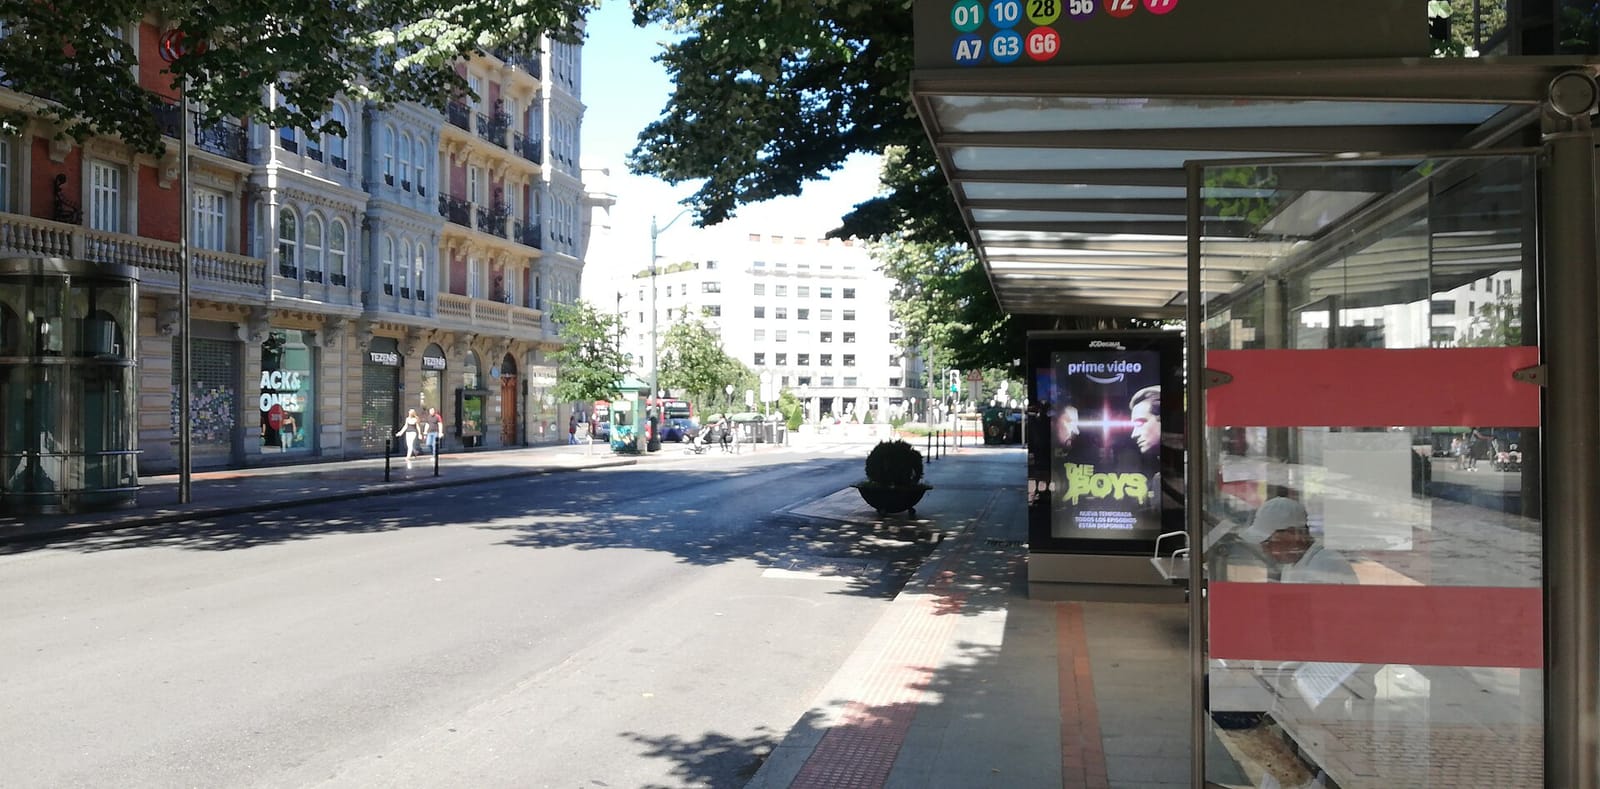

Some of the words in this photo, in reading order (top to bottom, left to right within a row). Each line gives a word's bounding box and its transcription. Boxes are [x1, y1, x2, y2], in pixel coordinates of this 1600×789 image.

[954, 5, 980, 25] 01
[994, 2, 1018, 22] 10
[1032, 0, 1055, 18] 28
[1069, 0, 1094, 15] 56
[955, 40, 982, 60] A7
[993, 36, 1019, 56] G3
[1029, 33, 1057, 54] G6
[1068, 361, 1105, 376] prime
[1107, 360, 1142, 373] video
[1063, 462, 1095, 477] THE
[1063, 473, 1148, 505] BOYS
